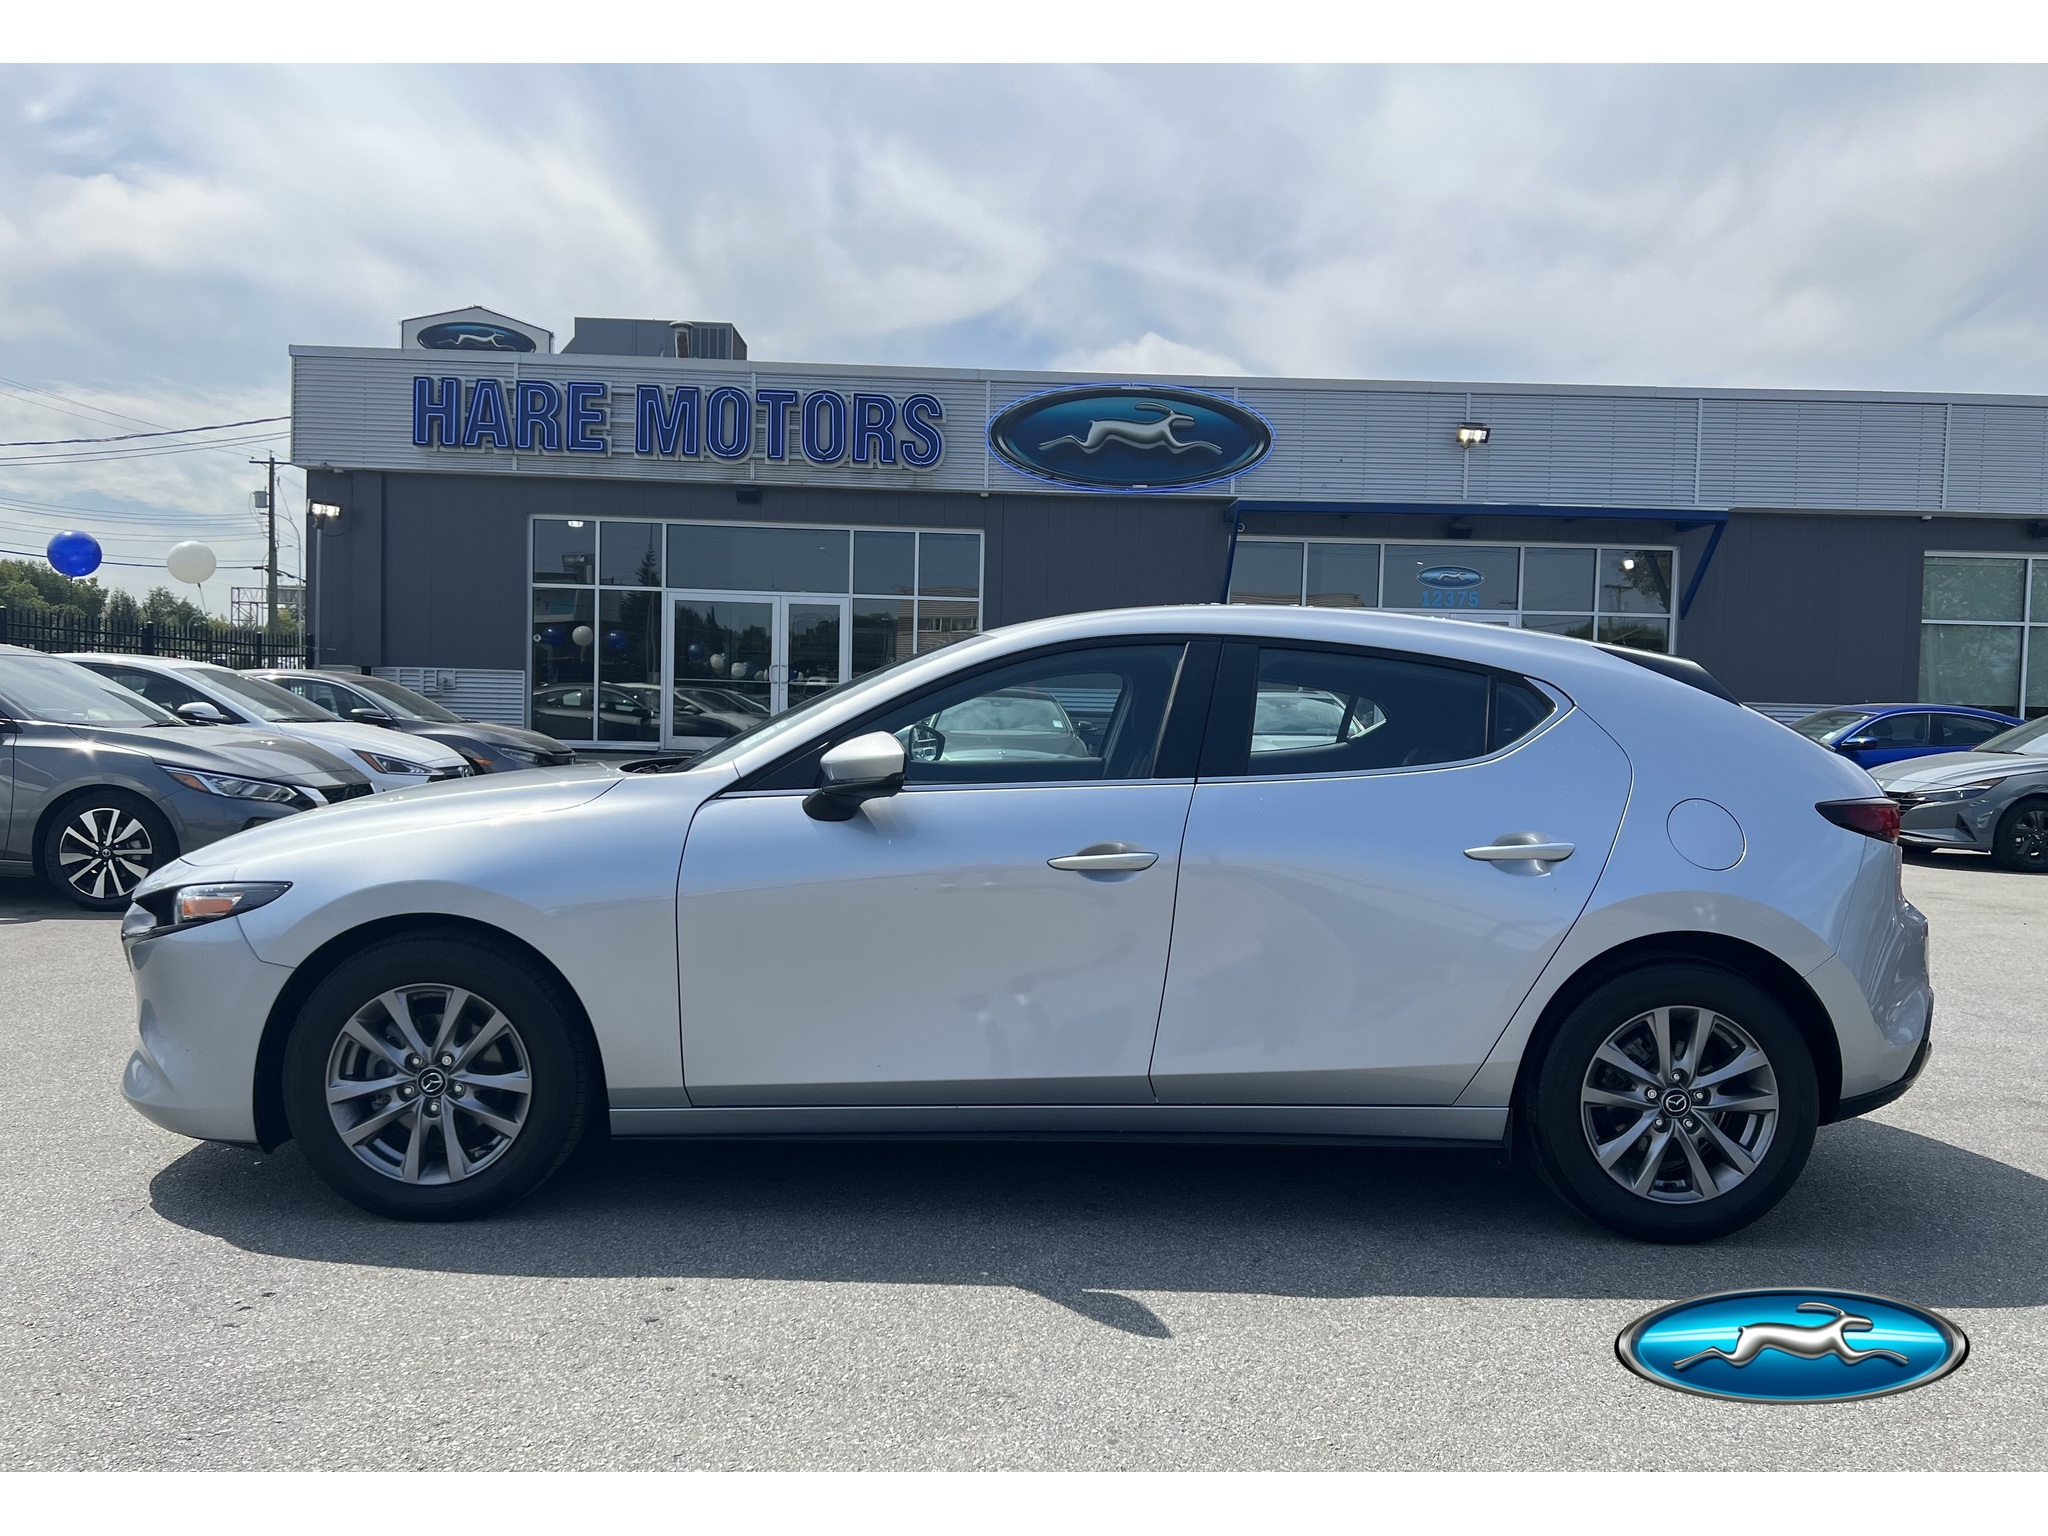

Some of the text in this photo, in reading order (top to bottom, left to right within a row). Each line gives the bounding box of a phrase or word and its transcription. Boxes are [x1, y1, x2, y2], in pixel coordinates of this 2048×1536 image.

[412, 375, 944, 467] HARE MOTORS
[1421, 590, 1479, 608] 12375
